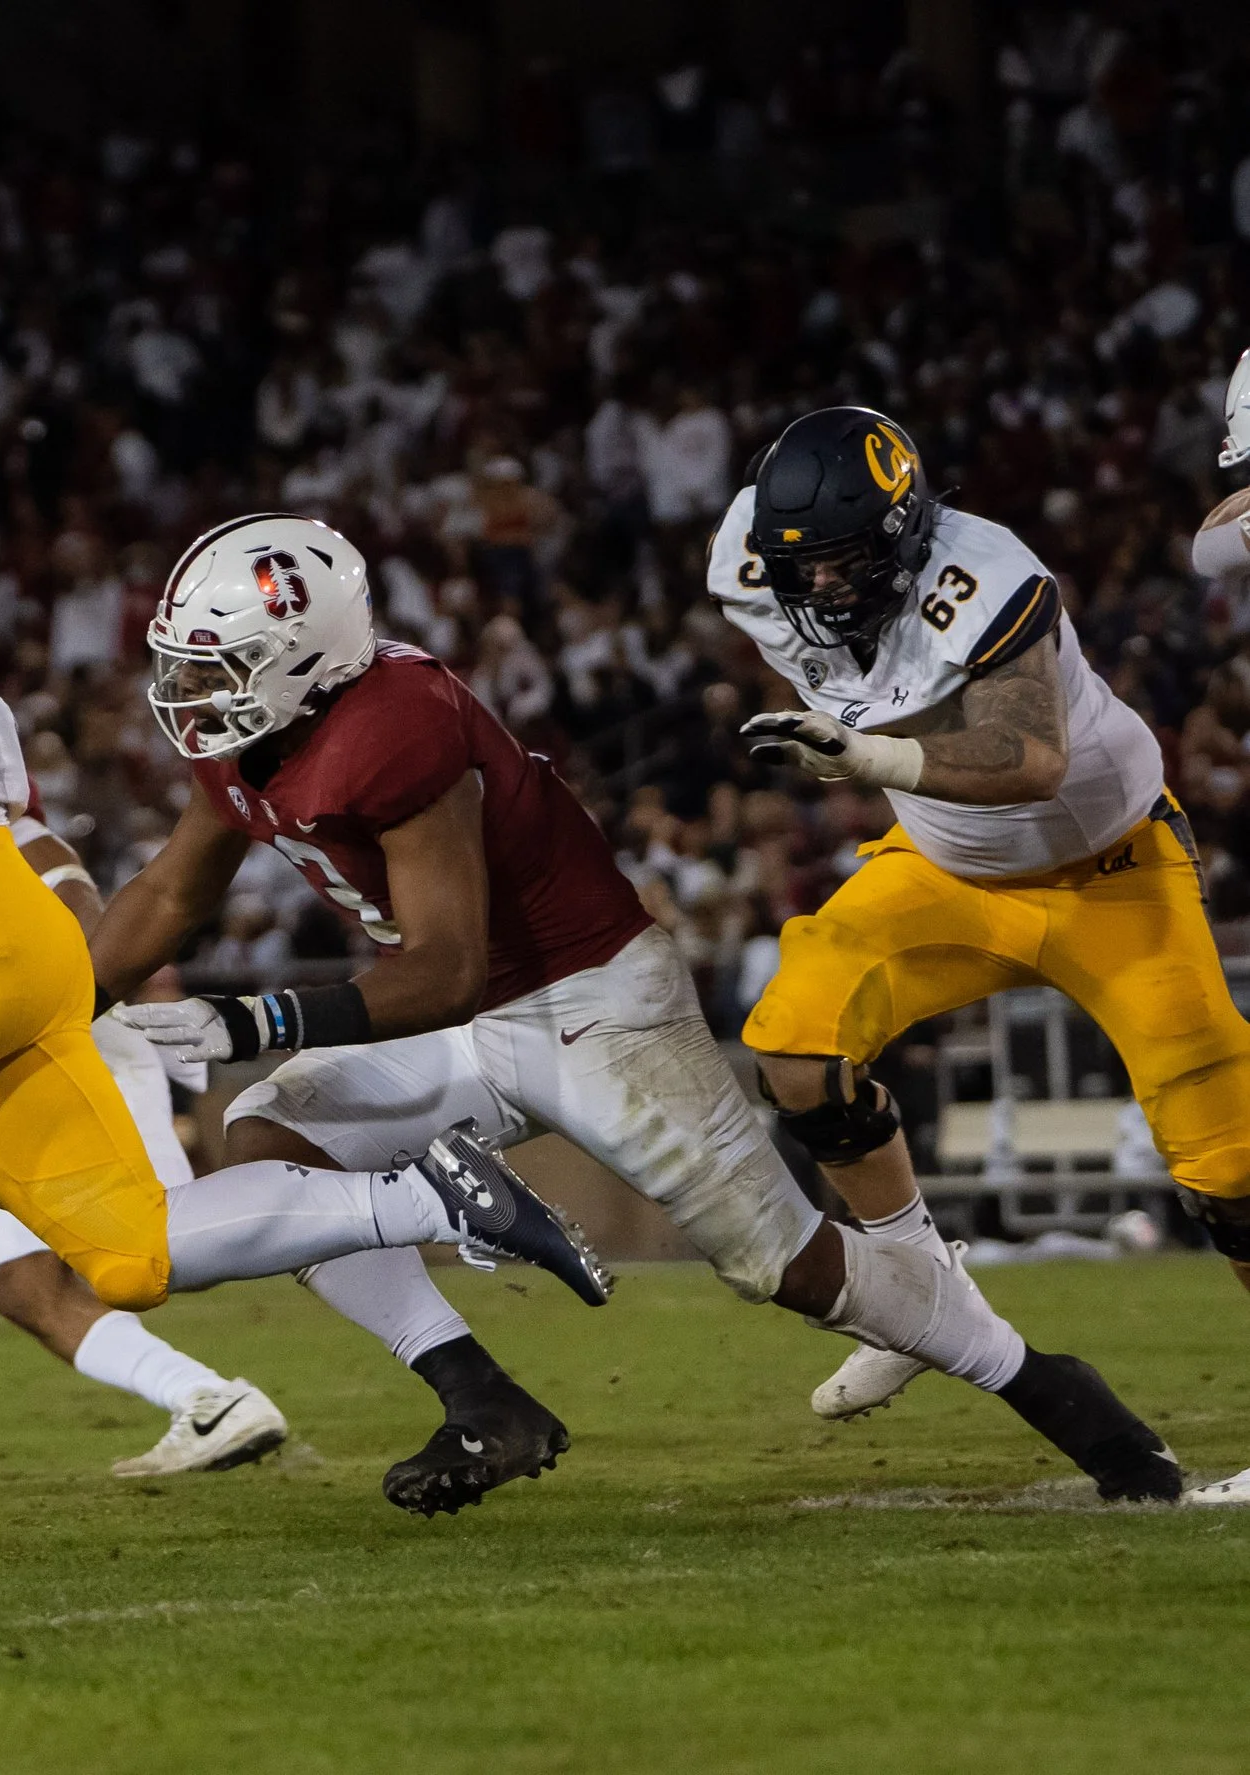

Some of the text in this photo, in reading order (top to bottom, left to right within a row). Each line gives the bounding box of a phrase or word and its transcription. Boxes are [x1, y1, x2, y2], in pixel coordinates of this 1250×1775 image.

[864, 422, 919, 506] Cal
[920, 564, 977, 633] 63
[839, 700, 871, 728] Cal
[1097, 841, 1138, 875] Cal
